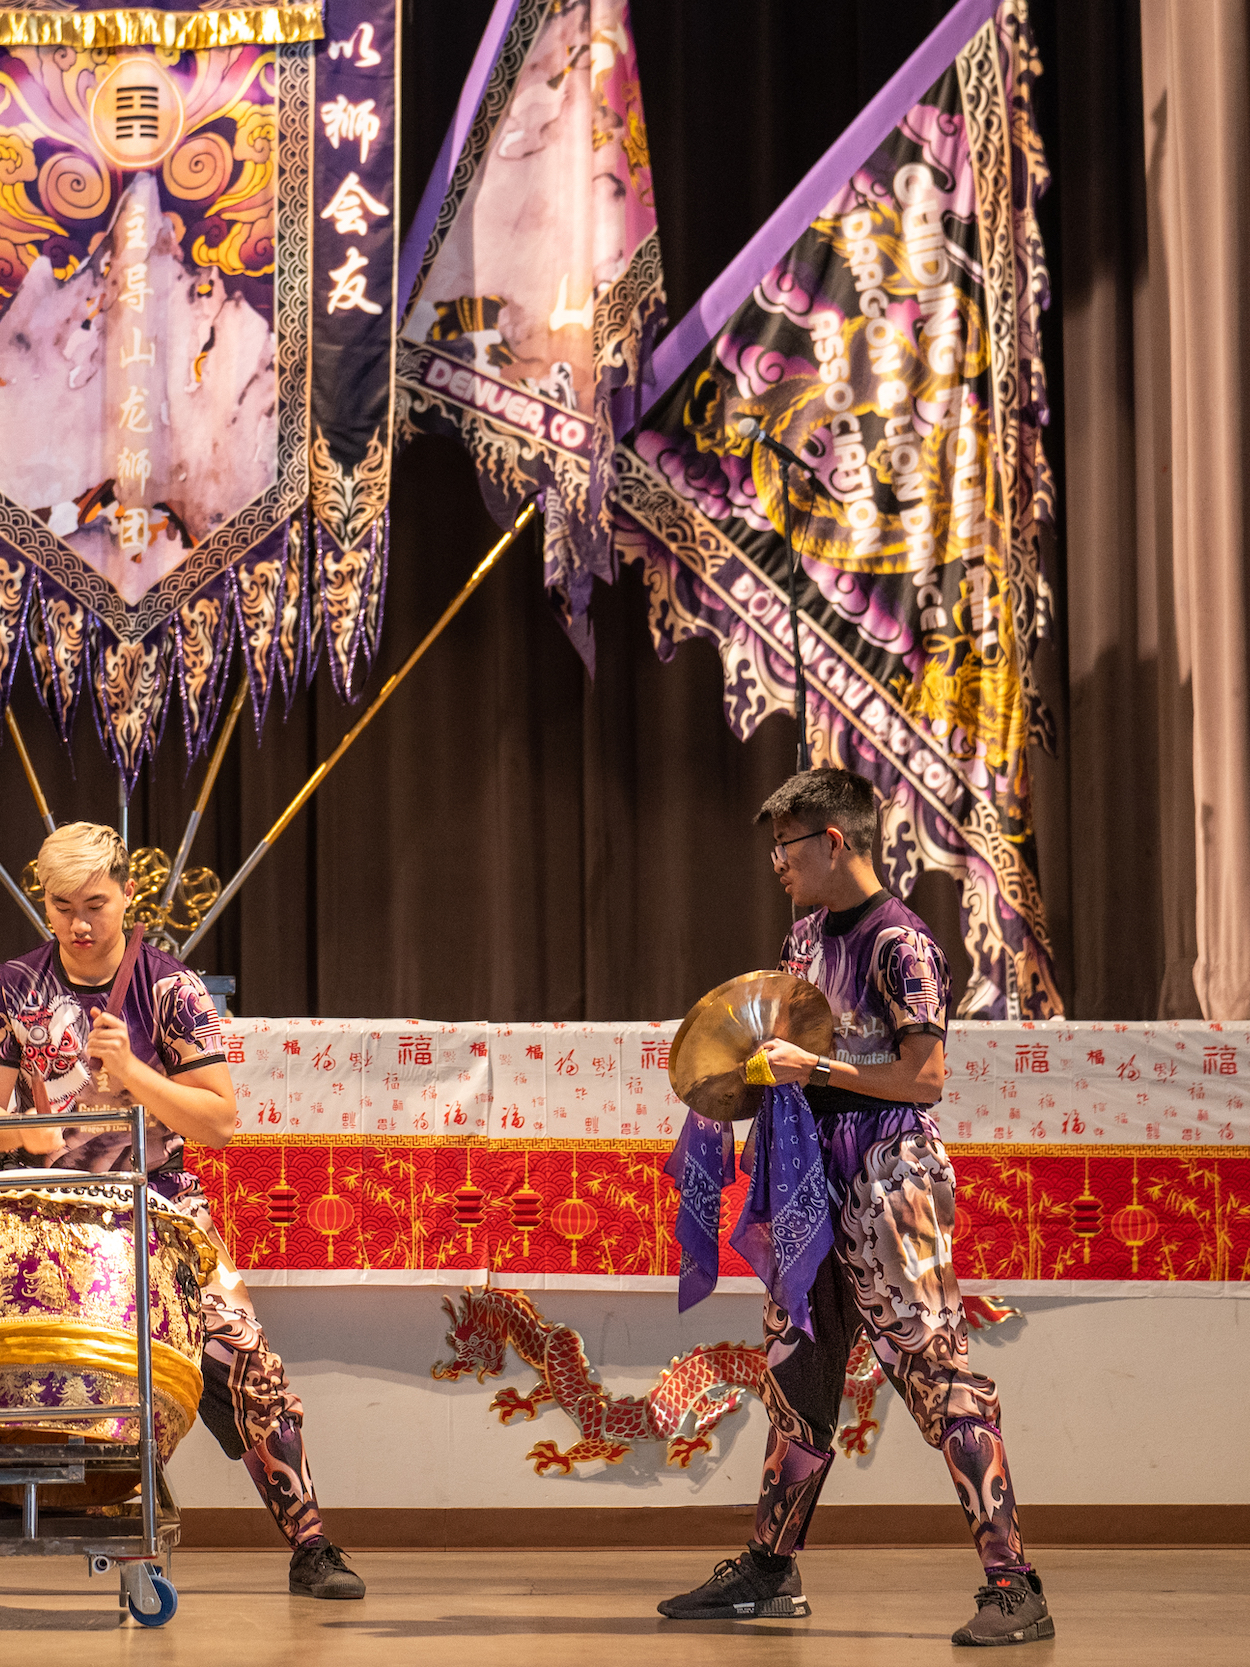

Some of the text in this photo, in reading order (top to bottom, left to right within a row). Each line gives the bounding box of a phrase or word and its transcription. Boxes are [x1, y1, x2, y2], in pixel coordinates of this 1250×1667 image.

[320, 22, 390, 315] 以狮会友
[842, 208, 903, 375] DRAGON
[550, 414, 588, 449] CO
[808, 309, 882, 557] ASSOCIATION
[886, 415, 929, 504] LION
[900, 504, 948, 631] DANCE
[282, 1039, 301, 1056] 福
[398, 1034, 433, 1065] 福
[469, 1041, 488, 1057] 福
[525, 1044, 544, 1061] 福
[836, 1049, 897, 1065] Mountain
[1015, 1042, 1050, 1074] 福
[1087, 1049, 1105, 1065] 福
[1203, 1044, 1238, 1075] 福
[383, 1072, 400, 1091] 福
[626, 1077, 643, 1094] 福
[1000, 1081, 1017, 1099] 福
[1188, 1083, 1205, 1099] 福
